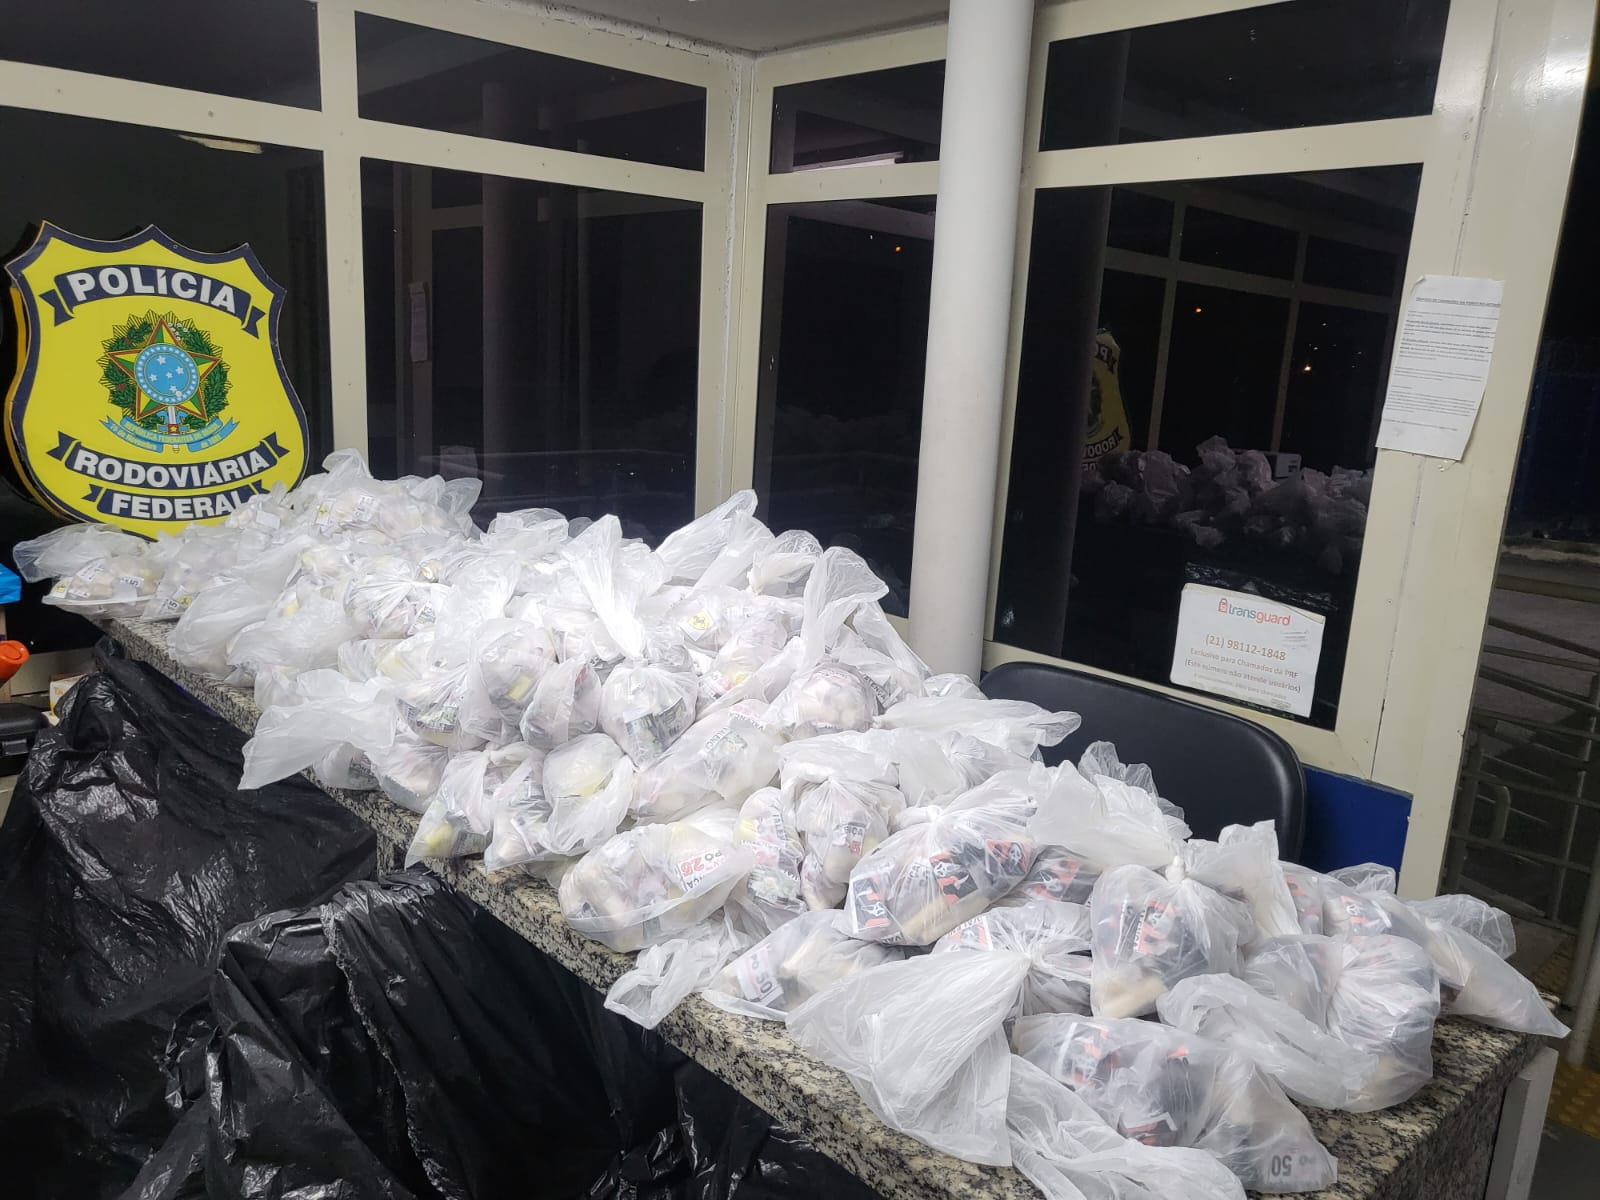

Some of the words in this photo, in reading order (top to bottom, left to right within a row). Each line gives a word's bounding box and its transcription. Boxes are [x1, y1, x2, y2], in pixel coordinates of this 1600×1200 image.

[66, 267, 236, 314] POLÍCIA
[73, 449, 270, 488] RODOVIÁRIA
[111, 490, 251, 519] FEDERAL
[1228, 603, 1291, 626] transguard
[1205, 634, 1225, 649] (21)
[1226, 639, 1286, 661] 98112-1848
[1271, 1155, 1292, 1176] 50
